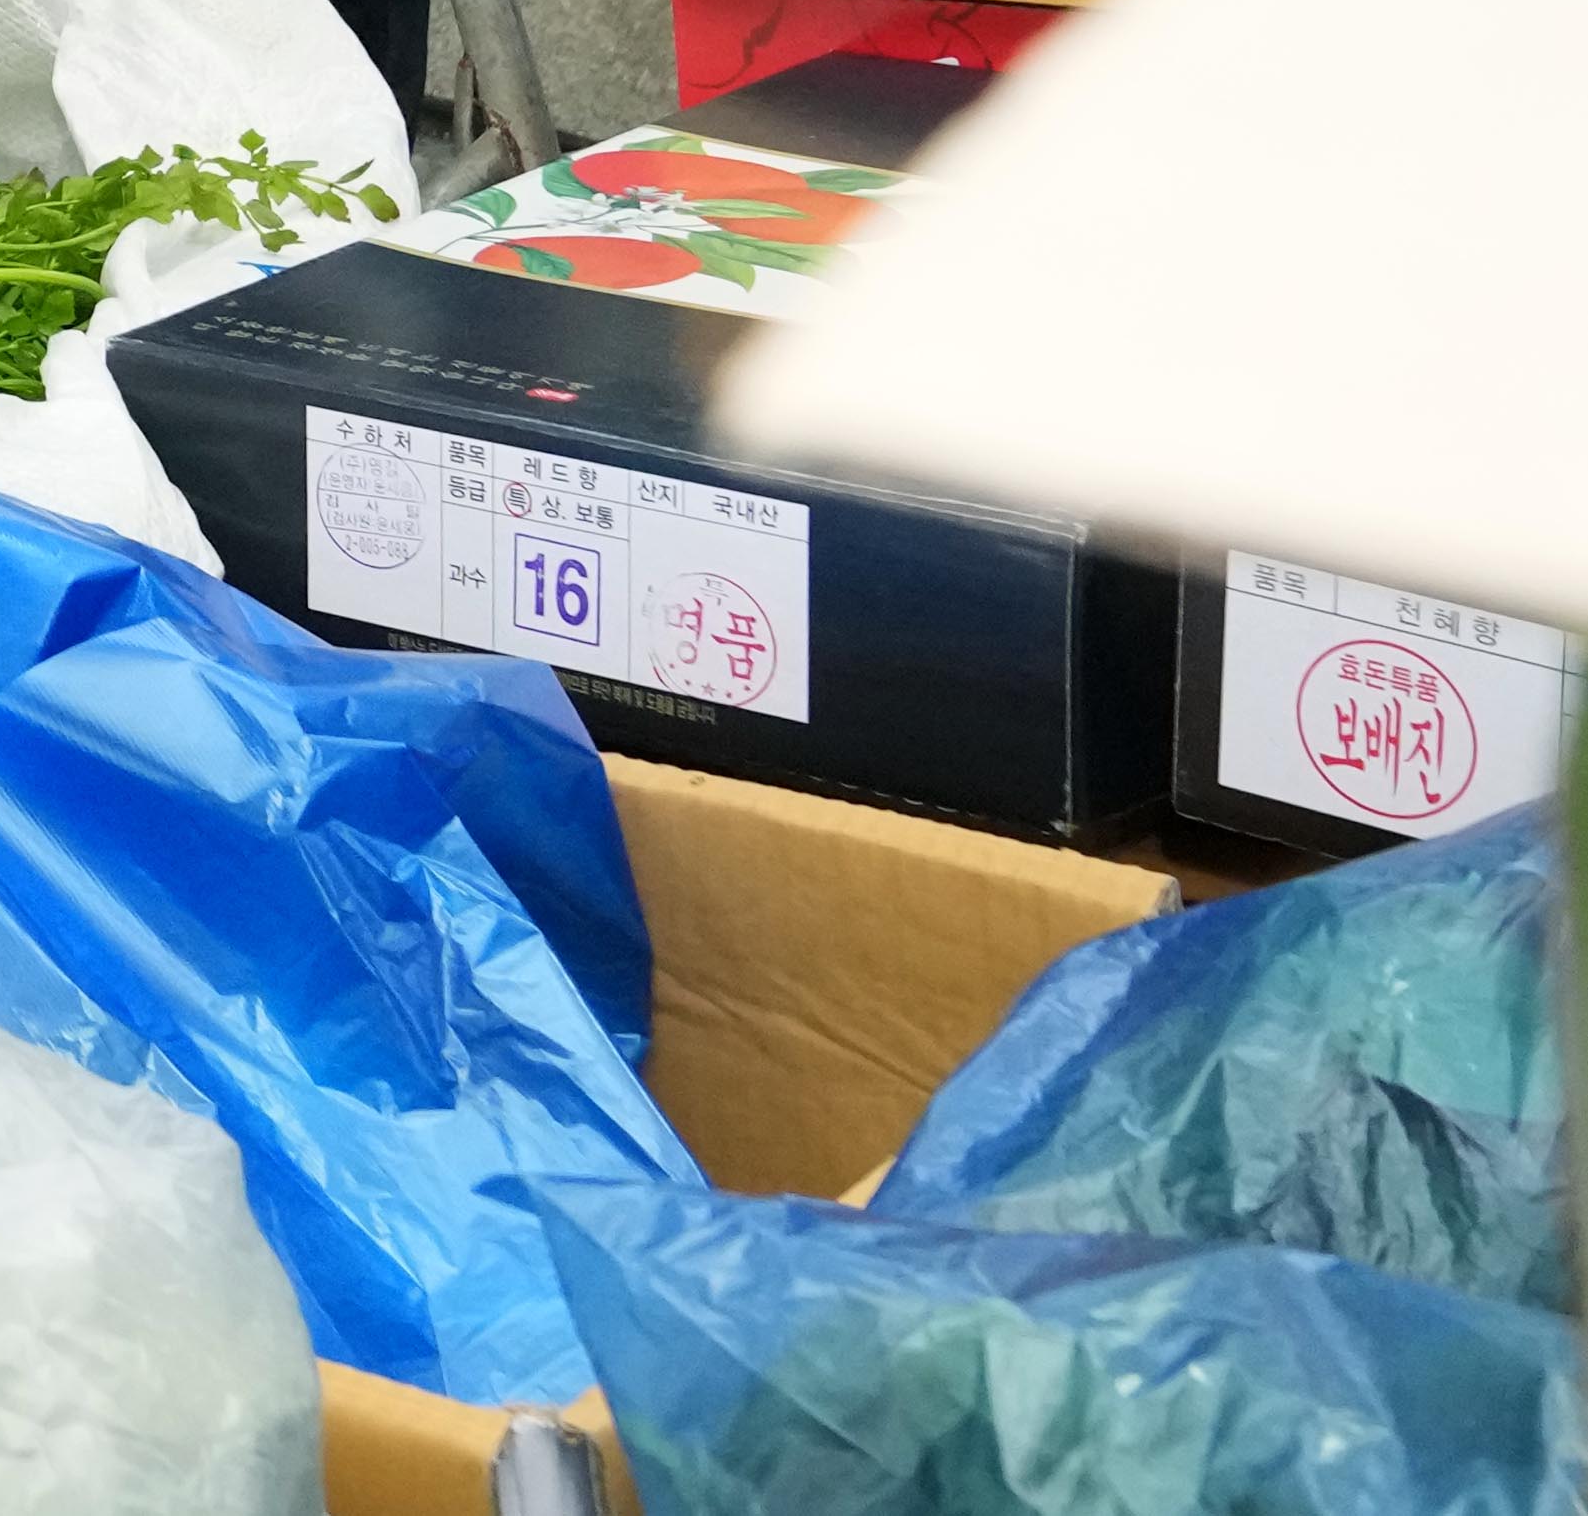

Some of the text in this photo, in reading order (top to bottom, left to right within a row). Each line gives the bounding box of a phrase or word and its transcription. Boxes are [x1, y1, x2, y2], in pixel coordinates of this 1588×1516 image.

[448, 440, 487, 469] 품목
[448, 475, 487, 504] 등급
[576, 502, 614, 530] 보통
[637, 478, 780, 529] 산지 국내산
[448, 561, 488, 590] 과수
[523, 552, 589, 627] 16
[1251, 562, 1308, 600] 품목
[1319, 696, 1446, 805] 보배진
